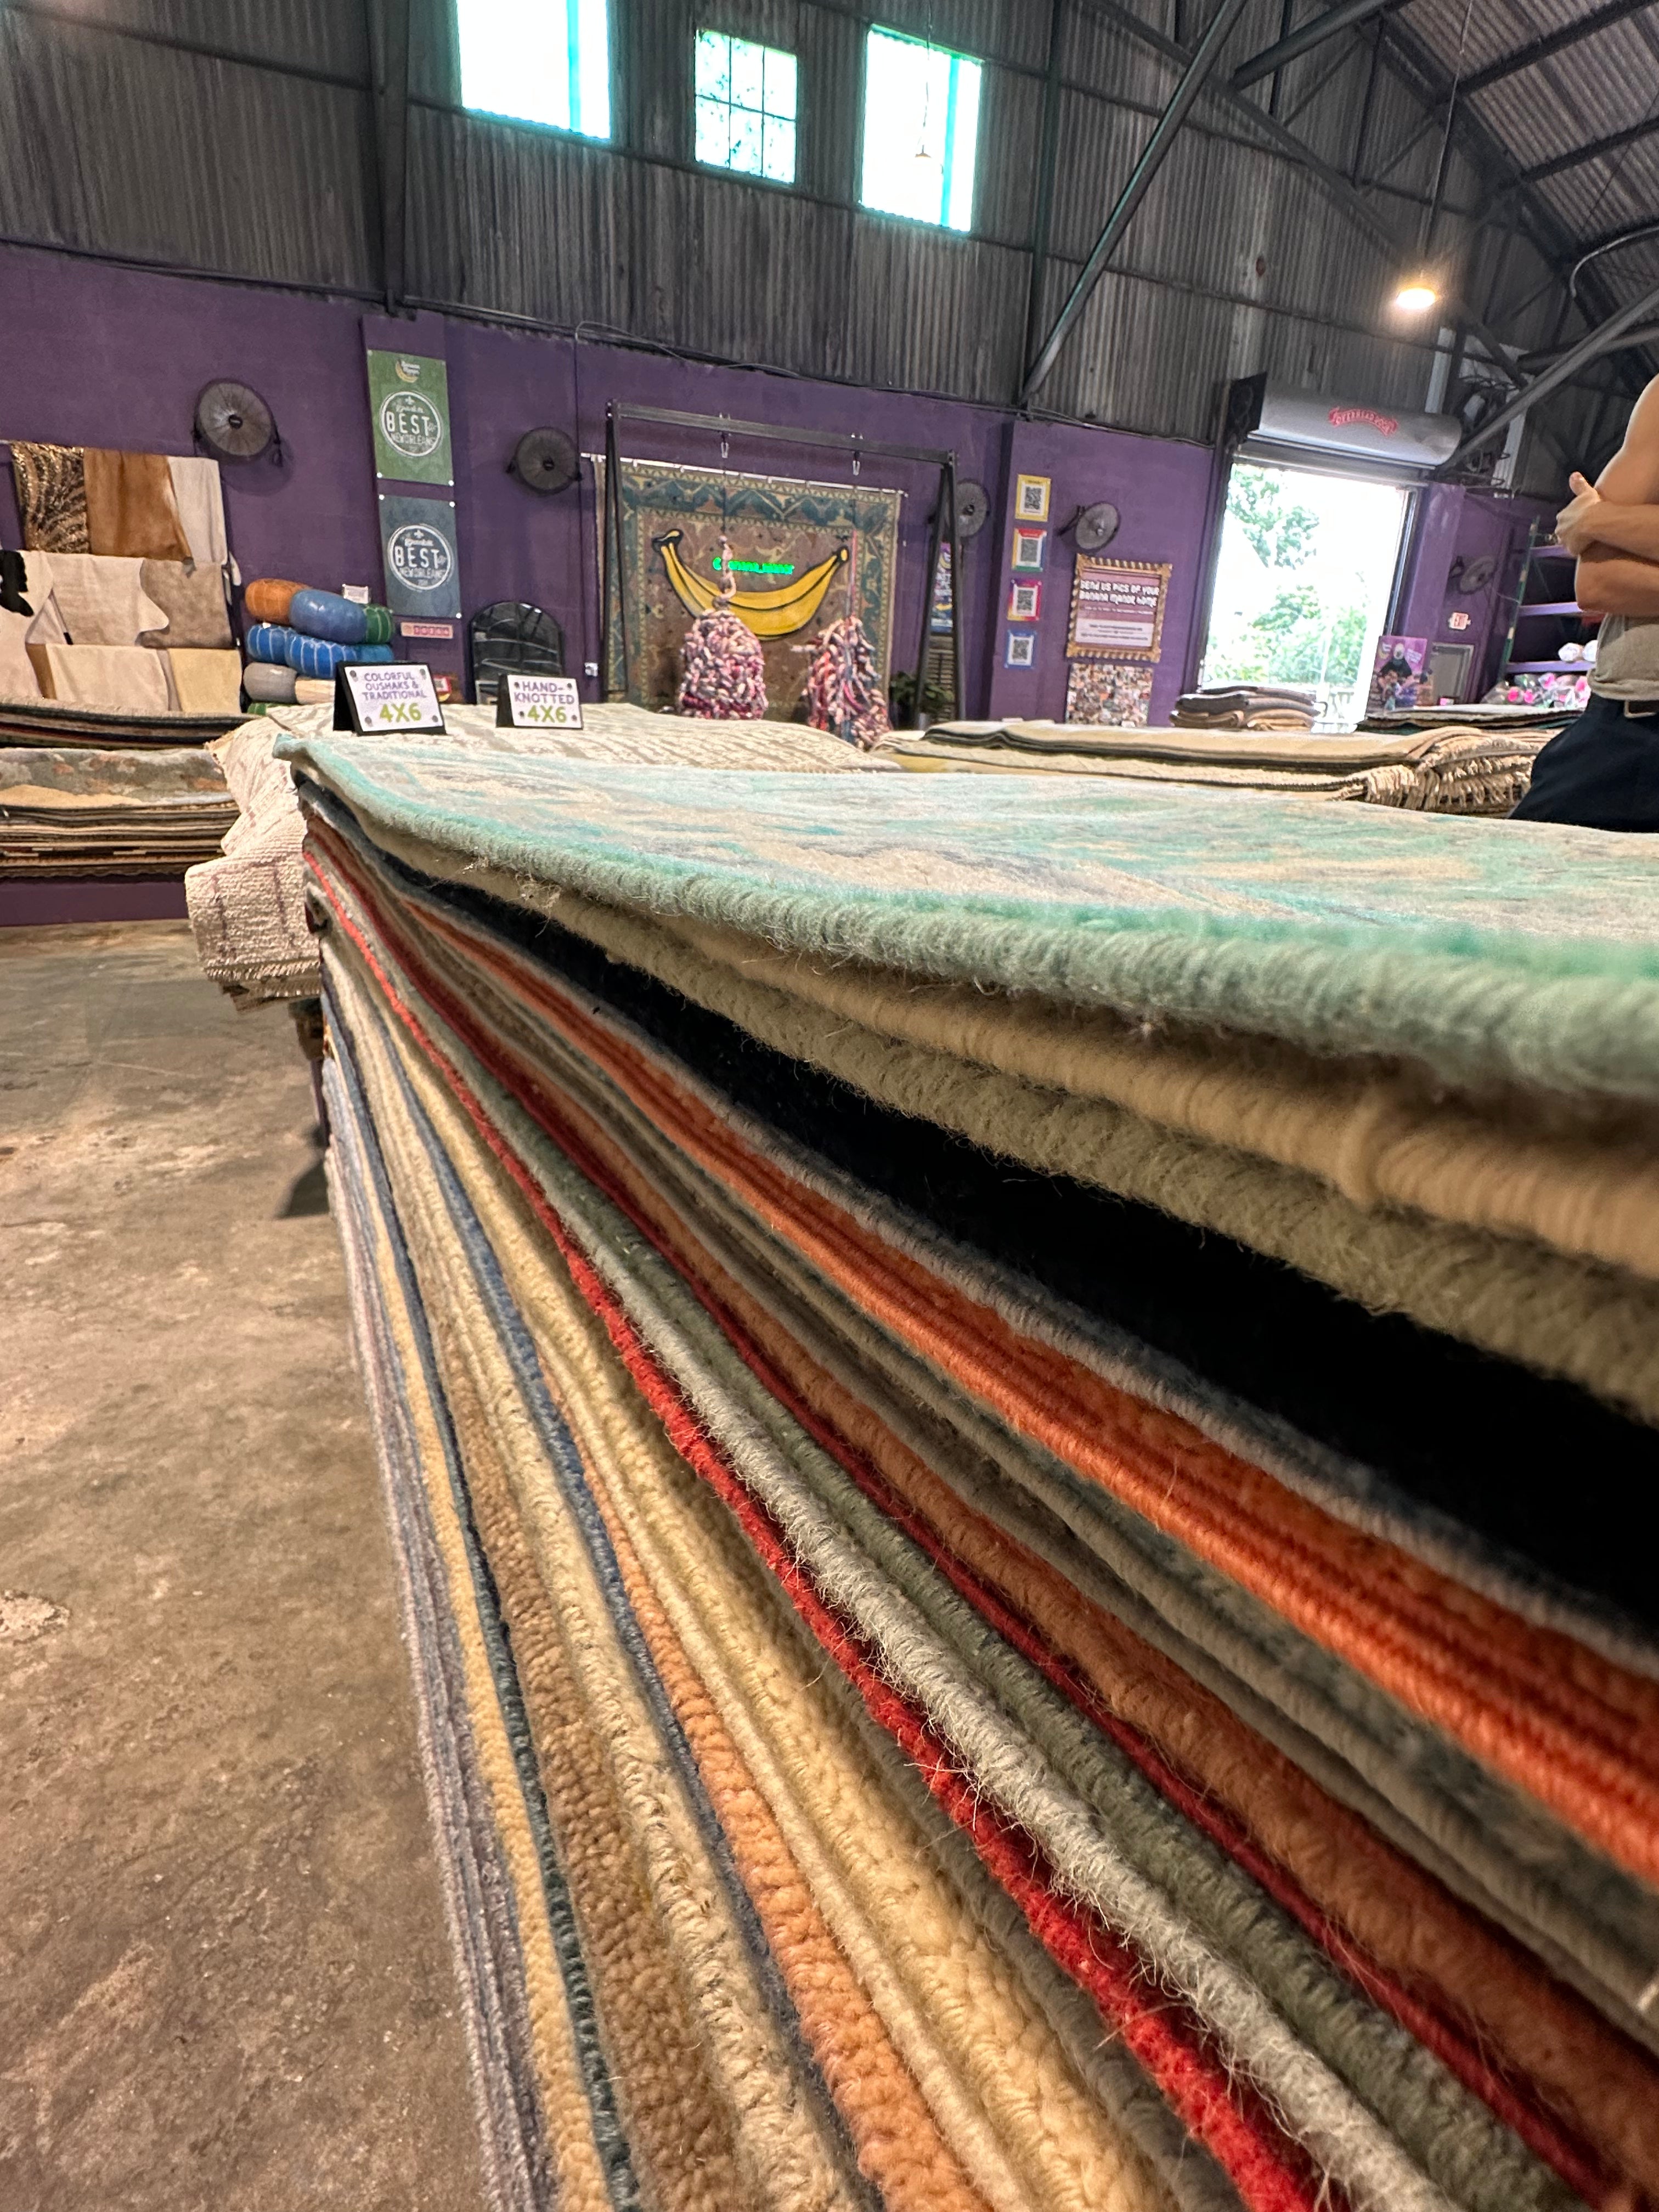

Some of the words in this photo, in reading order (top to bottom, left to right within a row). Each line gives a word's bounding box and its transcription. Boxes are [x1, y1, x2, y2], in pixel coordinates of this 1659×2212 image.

[386, 411, 430, 436] BEST
[394, 546, 439, 569] BEST
[364, 672, 415, 681] COLORFUL
[365, 681, 410, 691] OUSHAKS
[412, 681, 419, 689] &
[522, 681, 564, 693] HAND-
[362, 690, 427, 701] TRADITIONAL
[514, 691, 575, 704] KNOTTED
[380, 702, 422, 723] 4X6
[527, 705, 567, 723] 4X6
